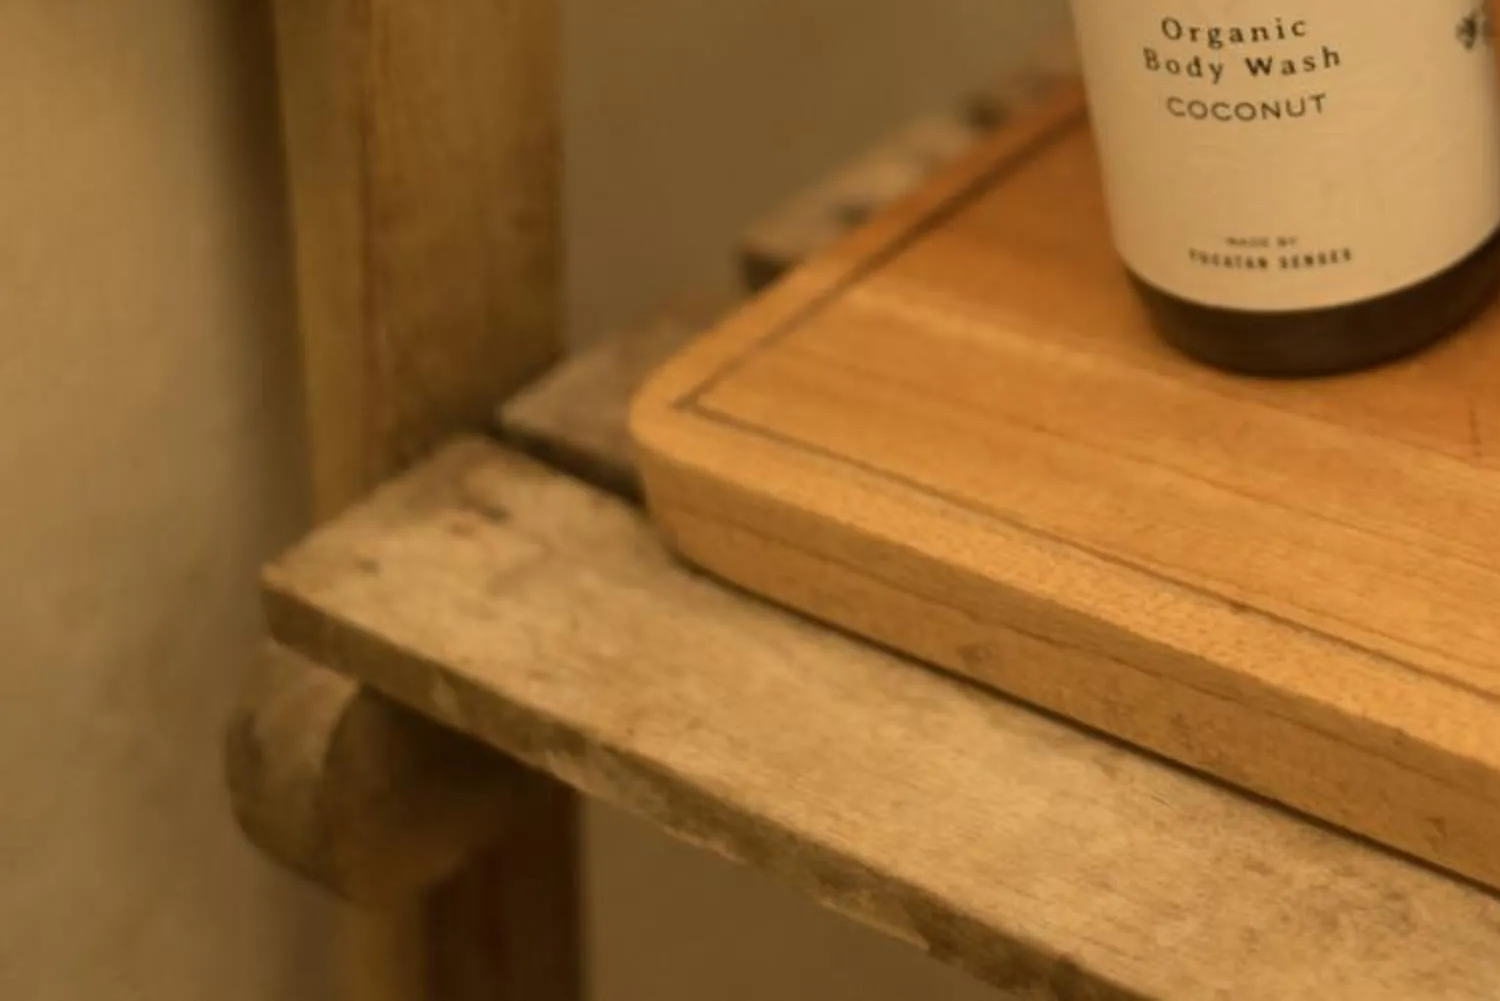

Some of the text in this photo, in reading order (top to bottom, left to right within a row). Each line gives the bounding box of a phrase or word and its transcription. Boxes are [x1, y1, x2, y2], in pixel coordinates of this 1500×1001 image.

[1161, 17, 1306, 50] Organic
[1143, 46, 1341, 84] Body Wash
[1166, 94, 1326, 121] COCONUT
